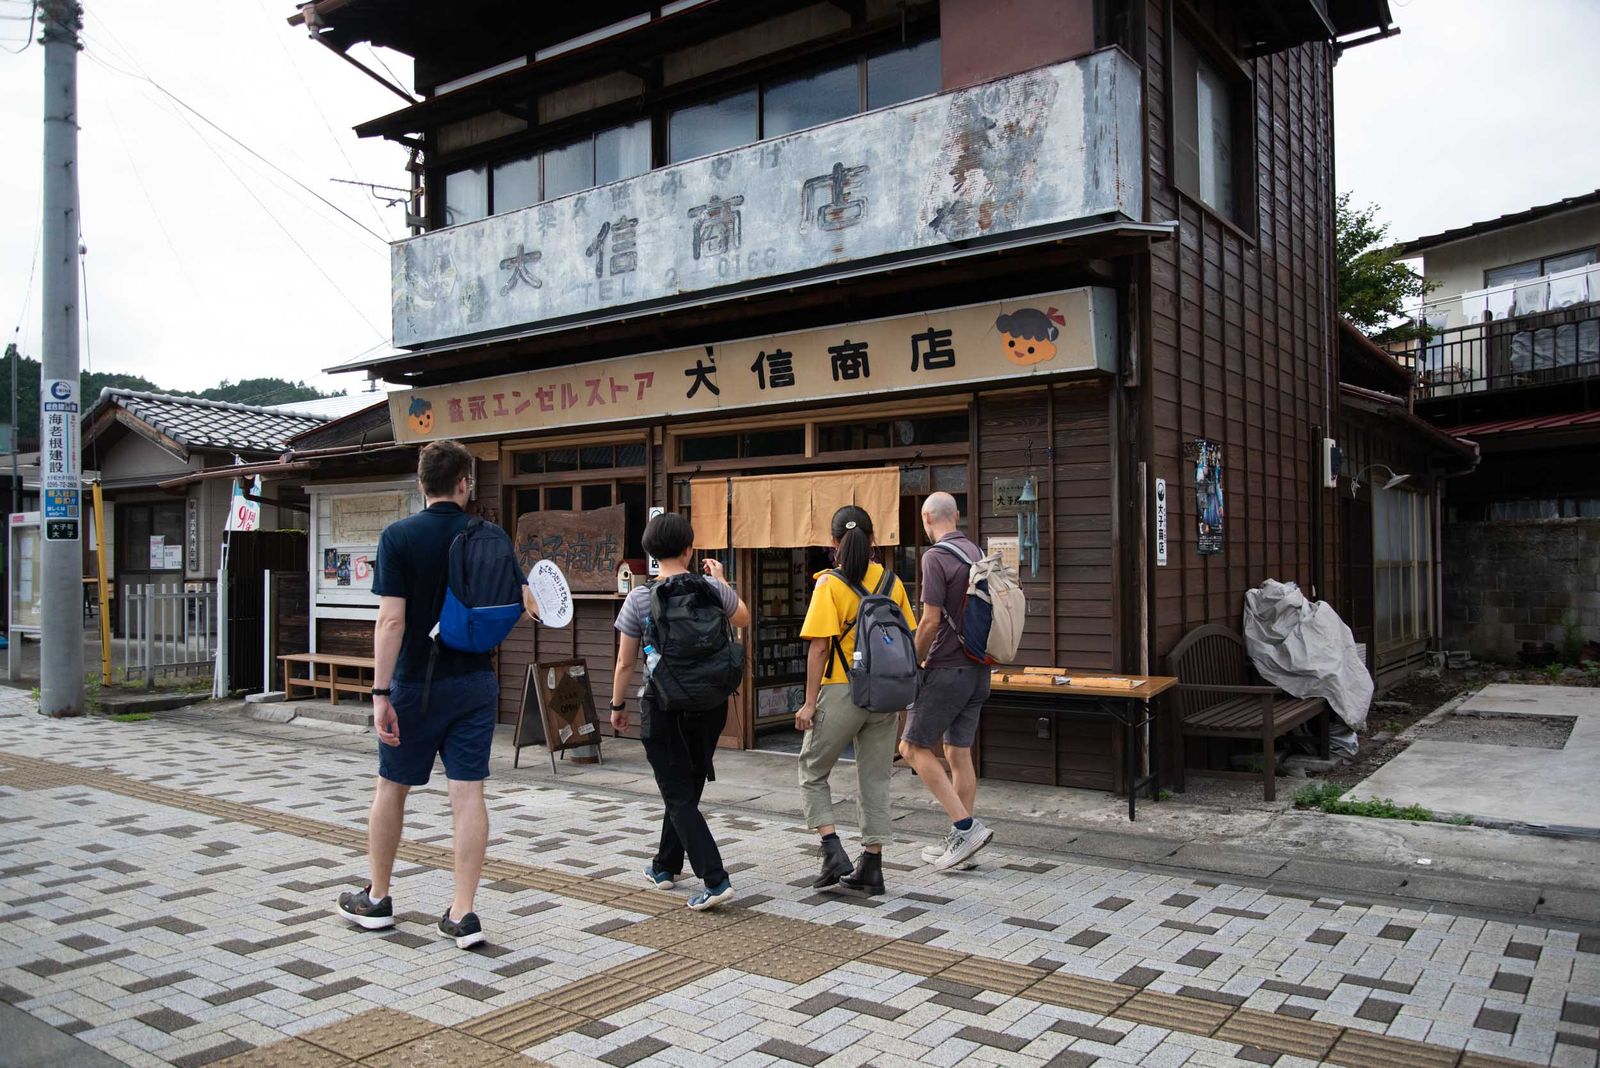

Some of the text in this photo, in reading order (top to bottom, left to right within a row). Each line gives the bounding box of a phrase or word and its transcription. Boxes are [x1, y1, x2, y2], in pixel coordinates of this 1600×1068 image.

[500, 161, 870, 297] 大信商店
[447, 371, 655, 423] 森永エンゼルストア
[48, 413, 63, 473] 海老根建設
